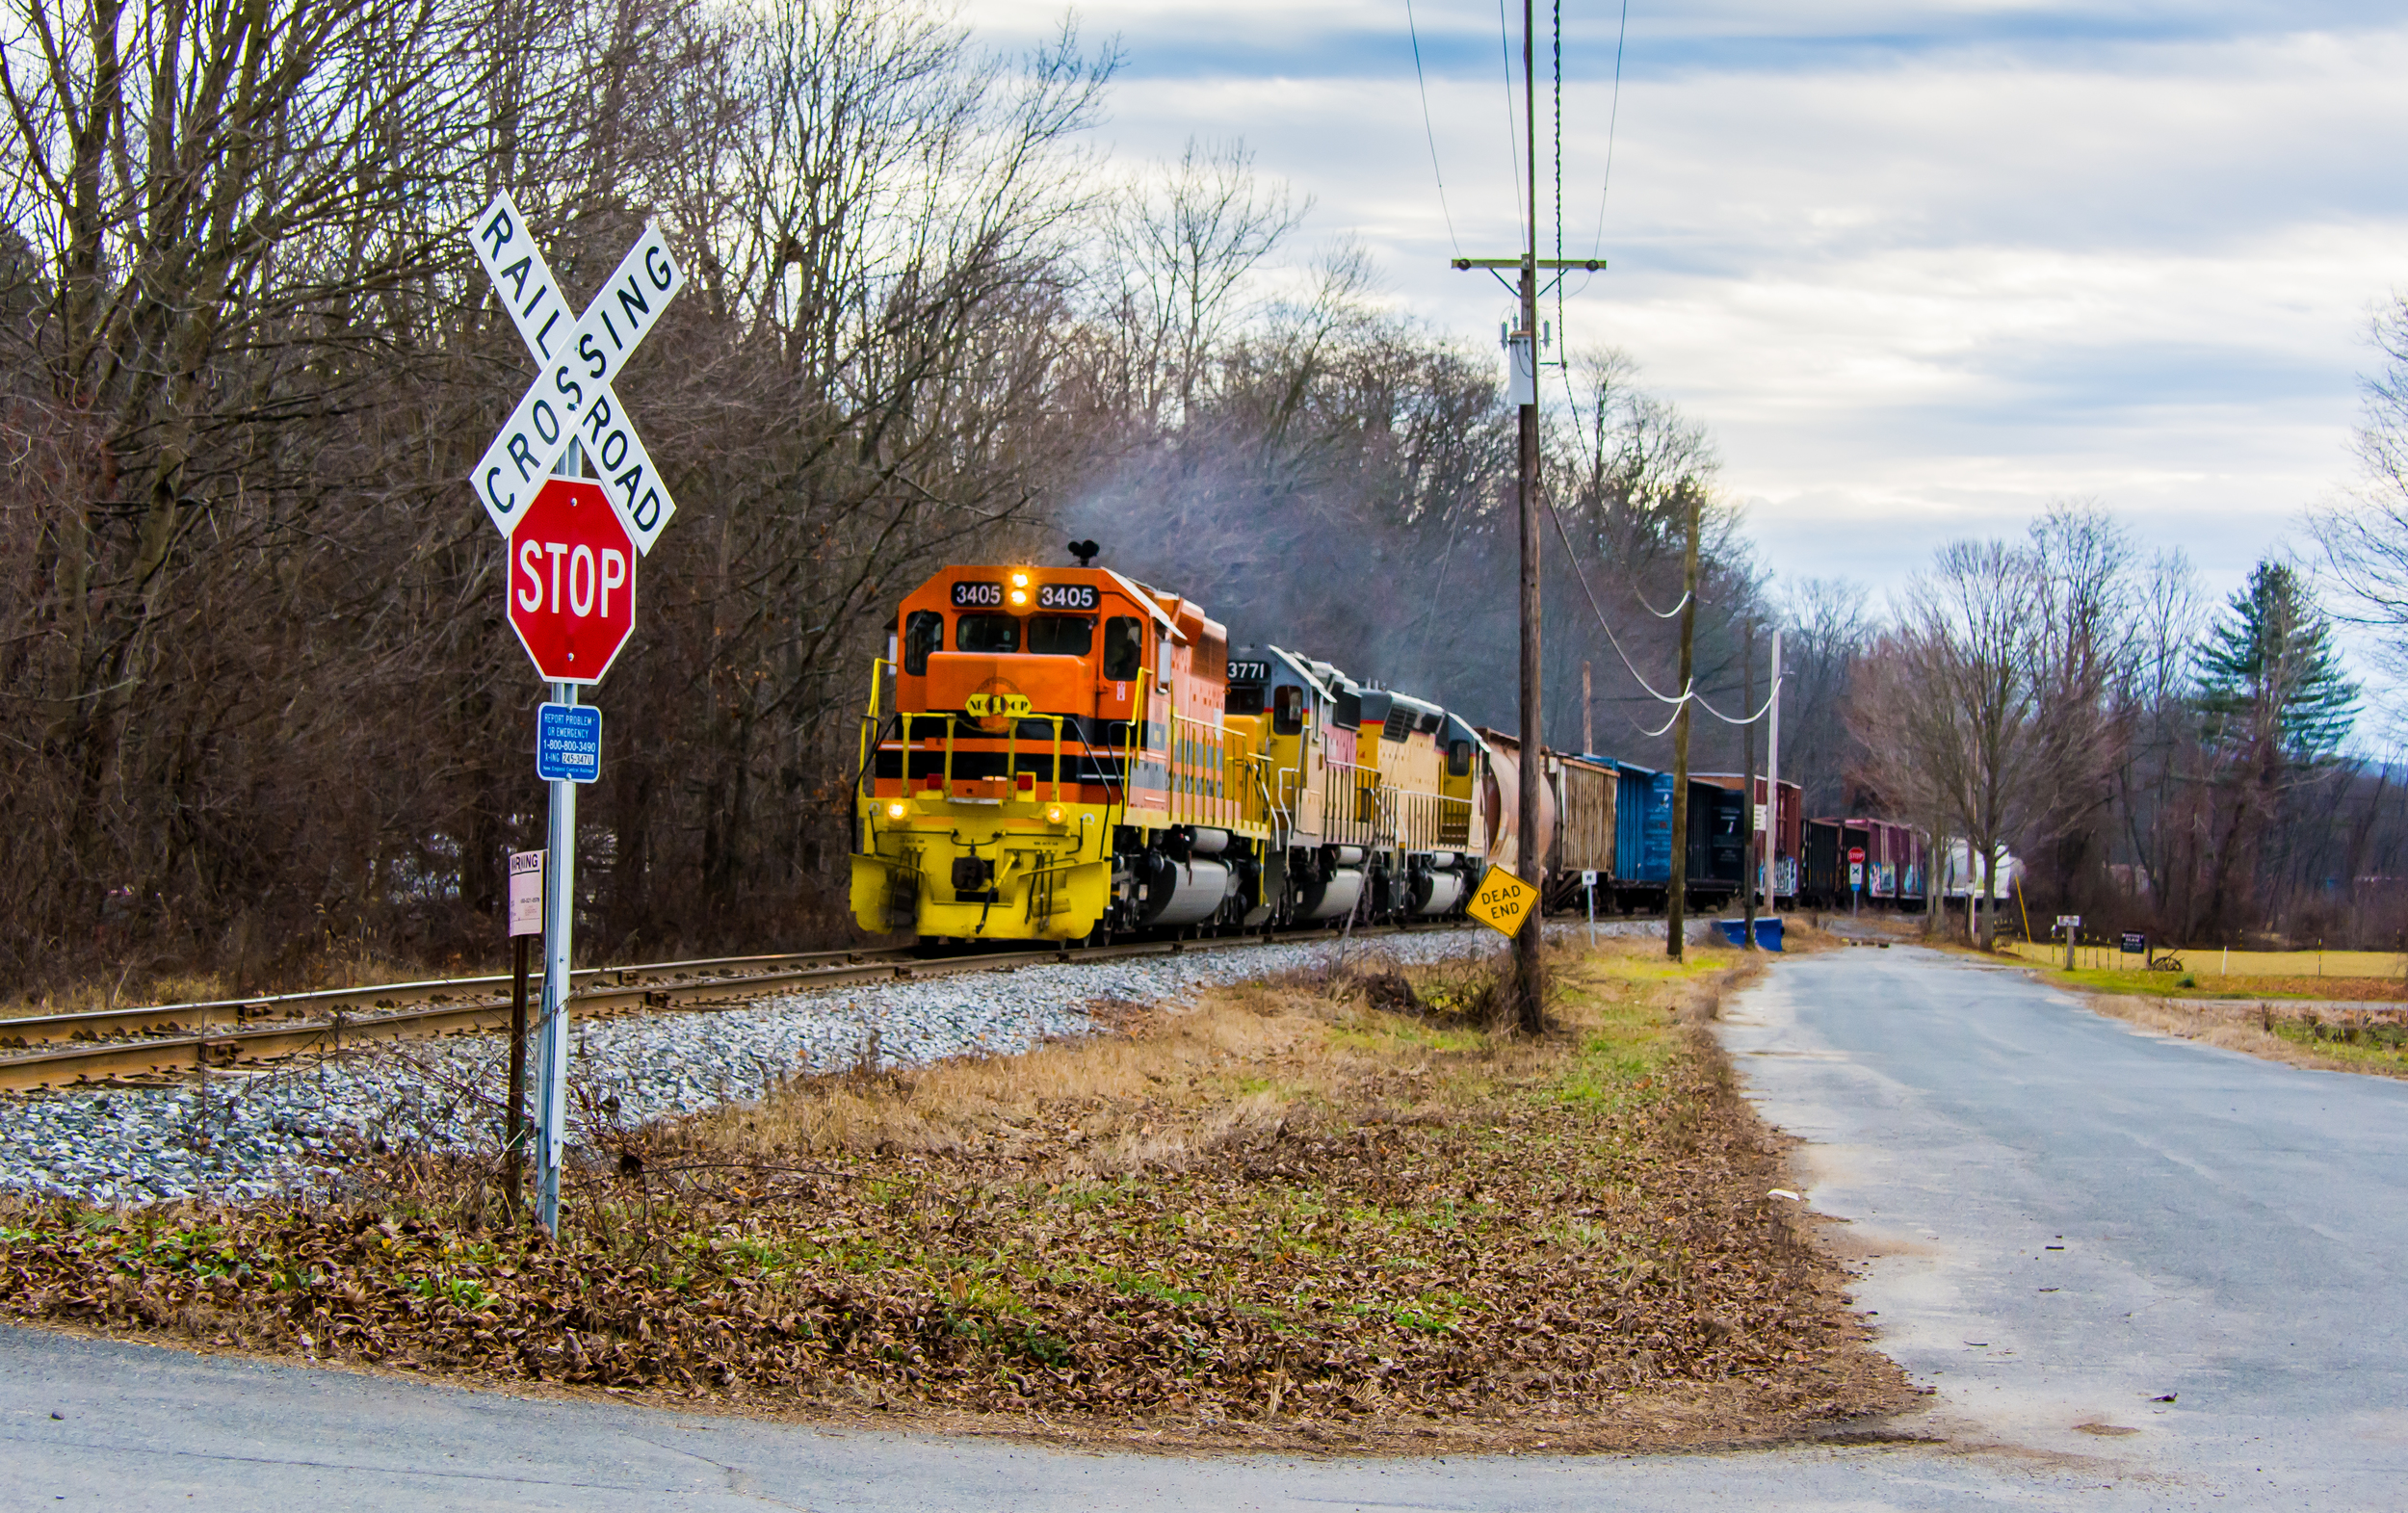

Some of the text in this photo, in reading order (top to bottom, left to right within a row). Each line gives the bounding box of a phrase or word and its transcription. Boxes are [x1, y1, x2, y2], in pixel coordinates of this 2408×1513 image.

[482, 208, 661, 533] RAIL ROAD
[486, 246, 671, 514] CROSSING
[518, 539, 626, 618] STOP
[956, 585, 1001, 604] 3405
[1041, 587, 1093, 607] 3405
[1227, 662, 1265, 679] 3771
[544, 713, 592, 726] REPORT PROBLEM
[547, 726, 589, 739] OR EMERGENCY
[543, 739, 596, 753] 1-800-800-3490
[545, 752, 561, 763] X-ING
[1481, 884, 1521, 905] DEAD
[1490, 901, 1520, 920] END
